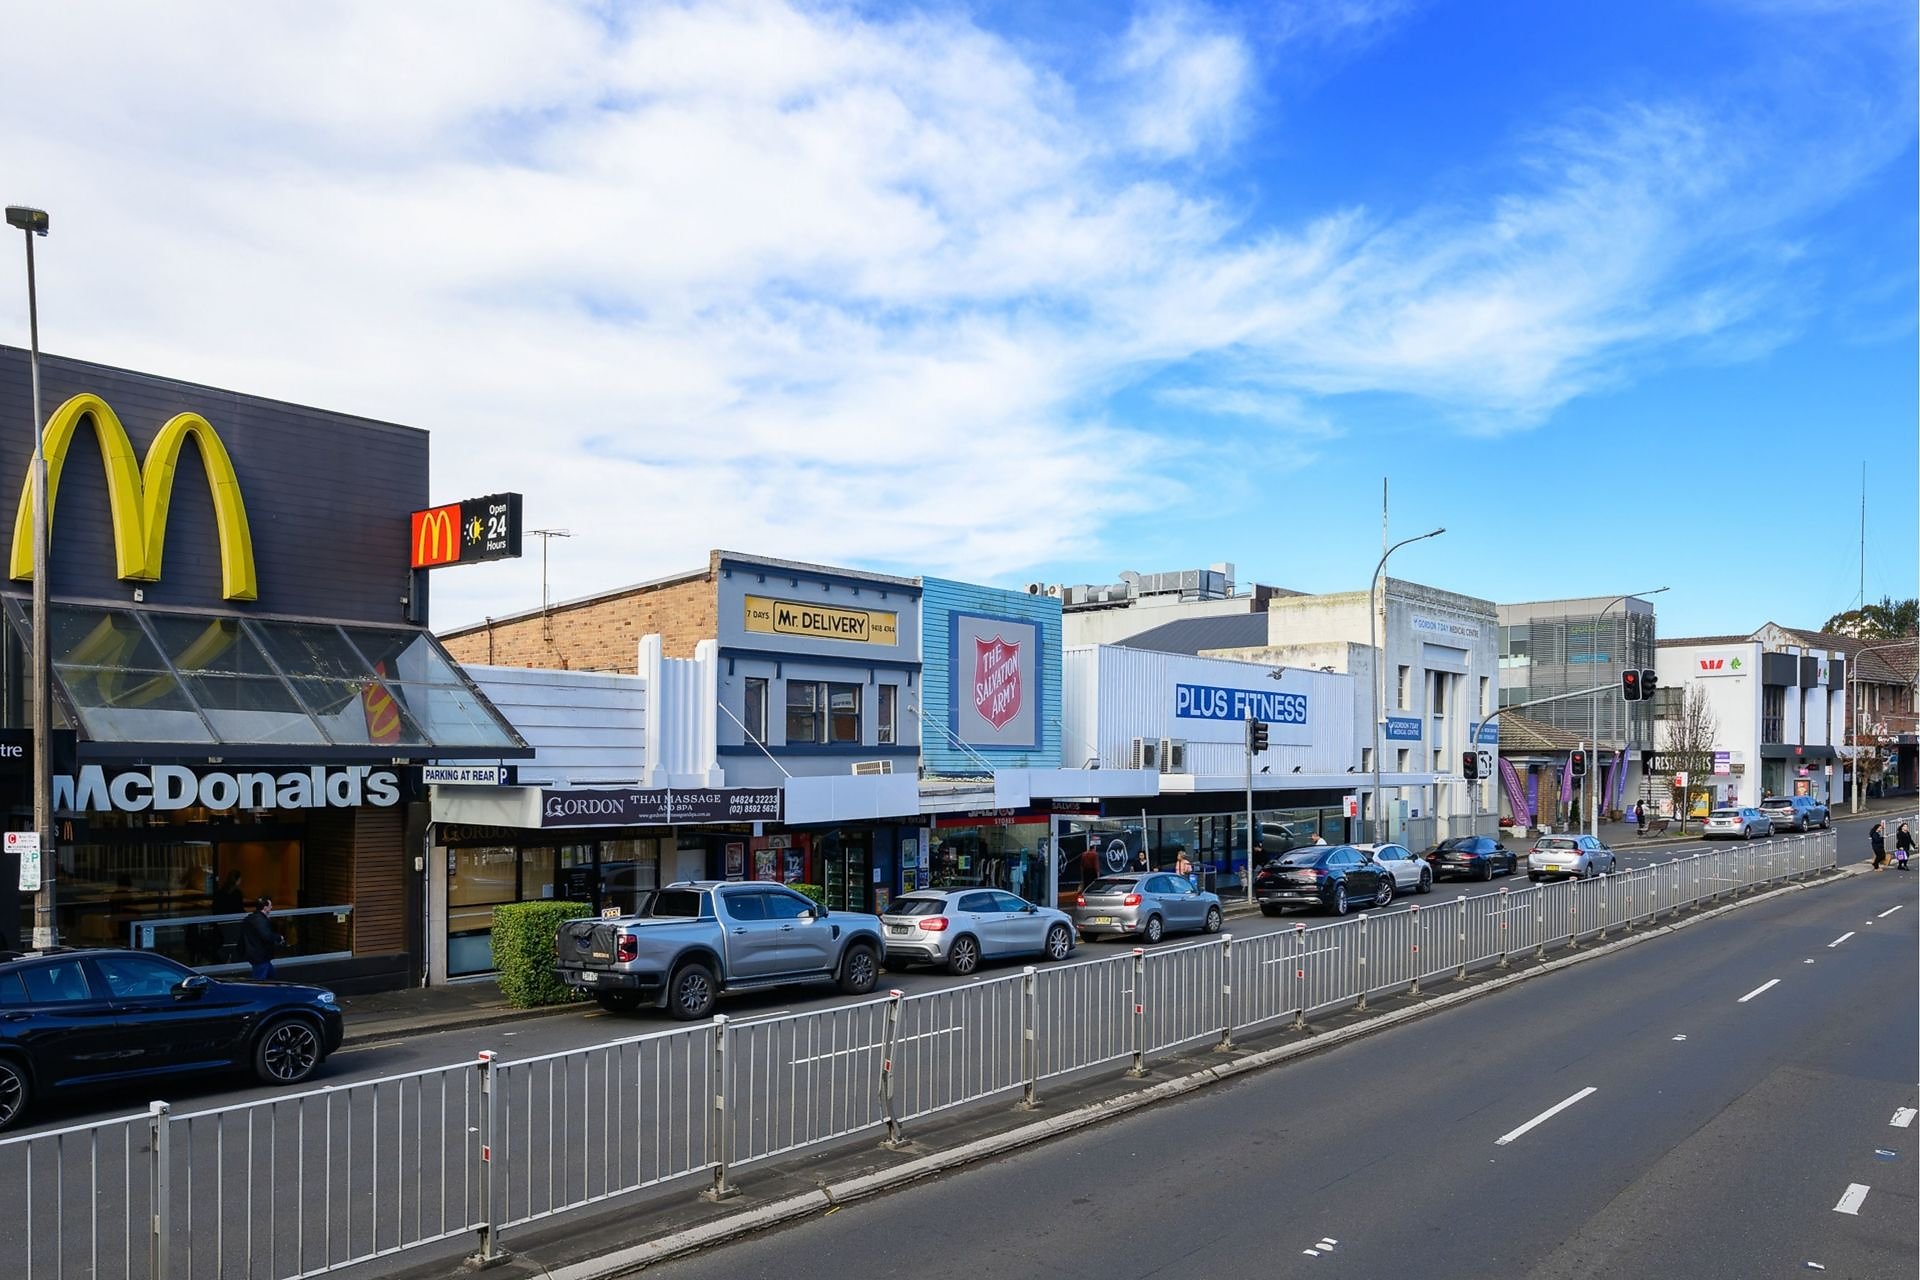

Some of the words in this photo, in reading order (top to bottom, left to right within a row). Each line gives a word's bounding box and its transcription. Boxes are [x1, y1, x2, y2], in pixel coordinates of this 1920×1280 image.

[489, 504, 506, 515] Open
[487, 515, 507, 539] 24
[486, 540, 506, 551] Hours
[746, 609, 751, 617] 7
[753, 611, 769, 620] DAYS
[778, 609, 799, 628] Mr.
[802, 612, 865, 634] DELIVERY
[1418, 619, 1436, 630] GORDON
[1449, 626, 1465, 636] MEDICAL
[1466, 629, 1479, 638] CENTRE
[983, 644, 1002, 673] THE
[976, 651, 1018, 706] SALVATION
[991, 677, 1017, 719] ARMY
[1177, 686, 1228, 718] PLUS
[1234, 692, 1306, 722] FITNESS
[0, 744, 23, 757] tre
[425, 770, 459, 780] PARKING
[461, 770, 472, 780] AT
[473, 771, 495, 781] REAR
[500, 768, 508, 784] P
[53, 765, 400, 812] McDonald's
[545, 796, 625, 818] GORDON
[630, 794, 661, 804] THAI
[664, 794, 721, 804] MASSAGE
[730, 795, 754, 804] 04824
[754, 795, 778, 804] 32233
[676, 804, 693, 812] SPA
[729, 805, 743, 815] (02)
[744, 804, 761, 813] 8592
[995, 817, 1015, 825] STORES
[788, 856, 800, 870] 12
